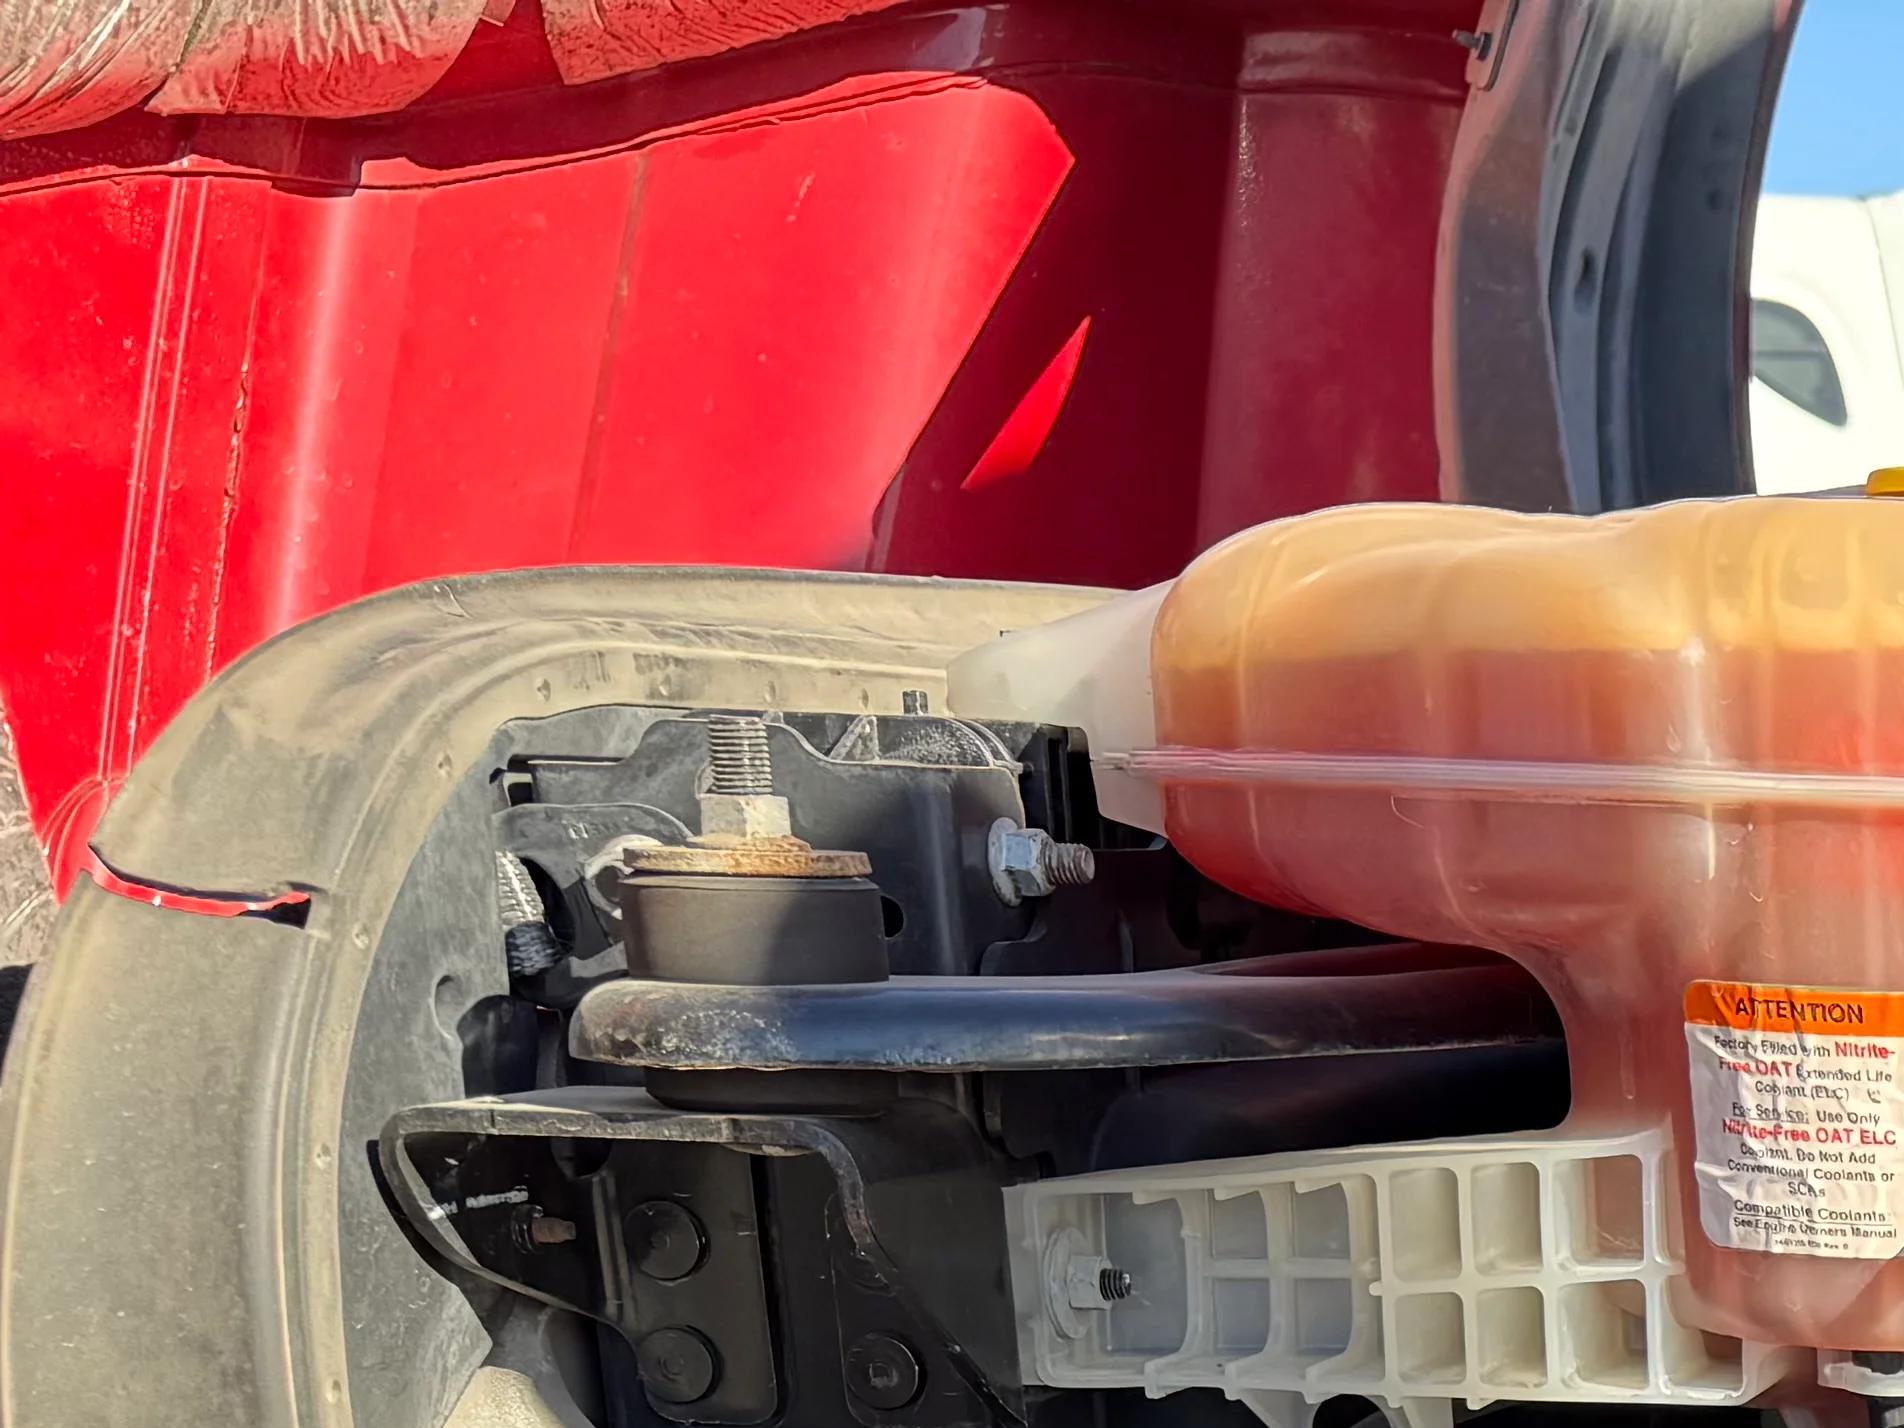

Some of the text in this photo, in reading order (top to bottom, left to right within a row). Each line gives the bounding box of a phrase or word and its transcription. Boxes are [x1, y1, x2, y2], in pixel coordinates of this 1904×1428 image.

[1735, 996, 1864, 1025] ATTENTION
[1714, 1035, 1758, 1054] Factory
[1760, 1040, 1798, 1057] Filled
[1834, 1041, 1896, 1060] Nitrite-
[1719, 1060, 1893, 1083] Free OAT Extended Life
[1754, 1081, 1806, 1097] Coolant
[1816, 1110, 1844, 1125] Use
[1847, 1111, 1881, 1128] Only
[1722, 1119, 1897, 1146] Nitrite-Free OAT ELC
[1796, 1147, 1816, 1162] Do
[1819, 1150, 1845, 1164] Not
[1848, 1151, 1877, 1165] Add
[1727, 1159, 1896, 1183] Conventional Coolants or
[1734, 1199, 1814, 1223] Compatible
[1733, 1216, 1755, 1231] See
[1851, 1225, 1898, 1239] Manual
